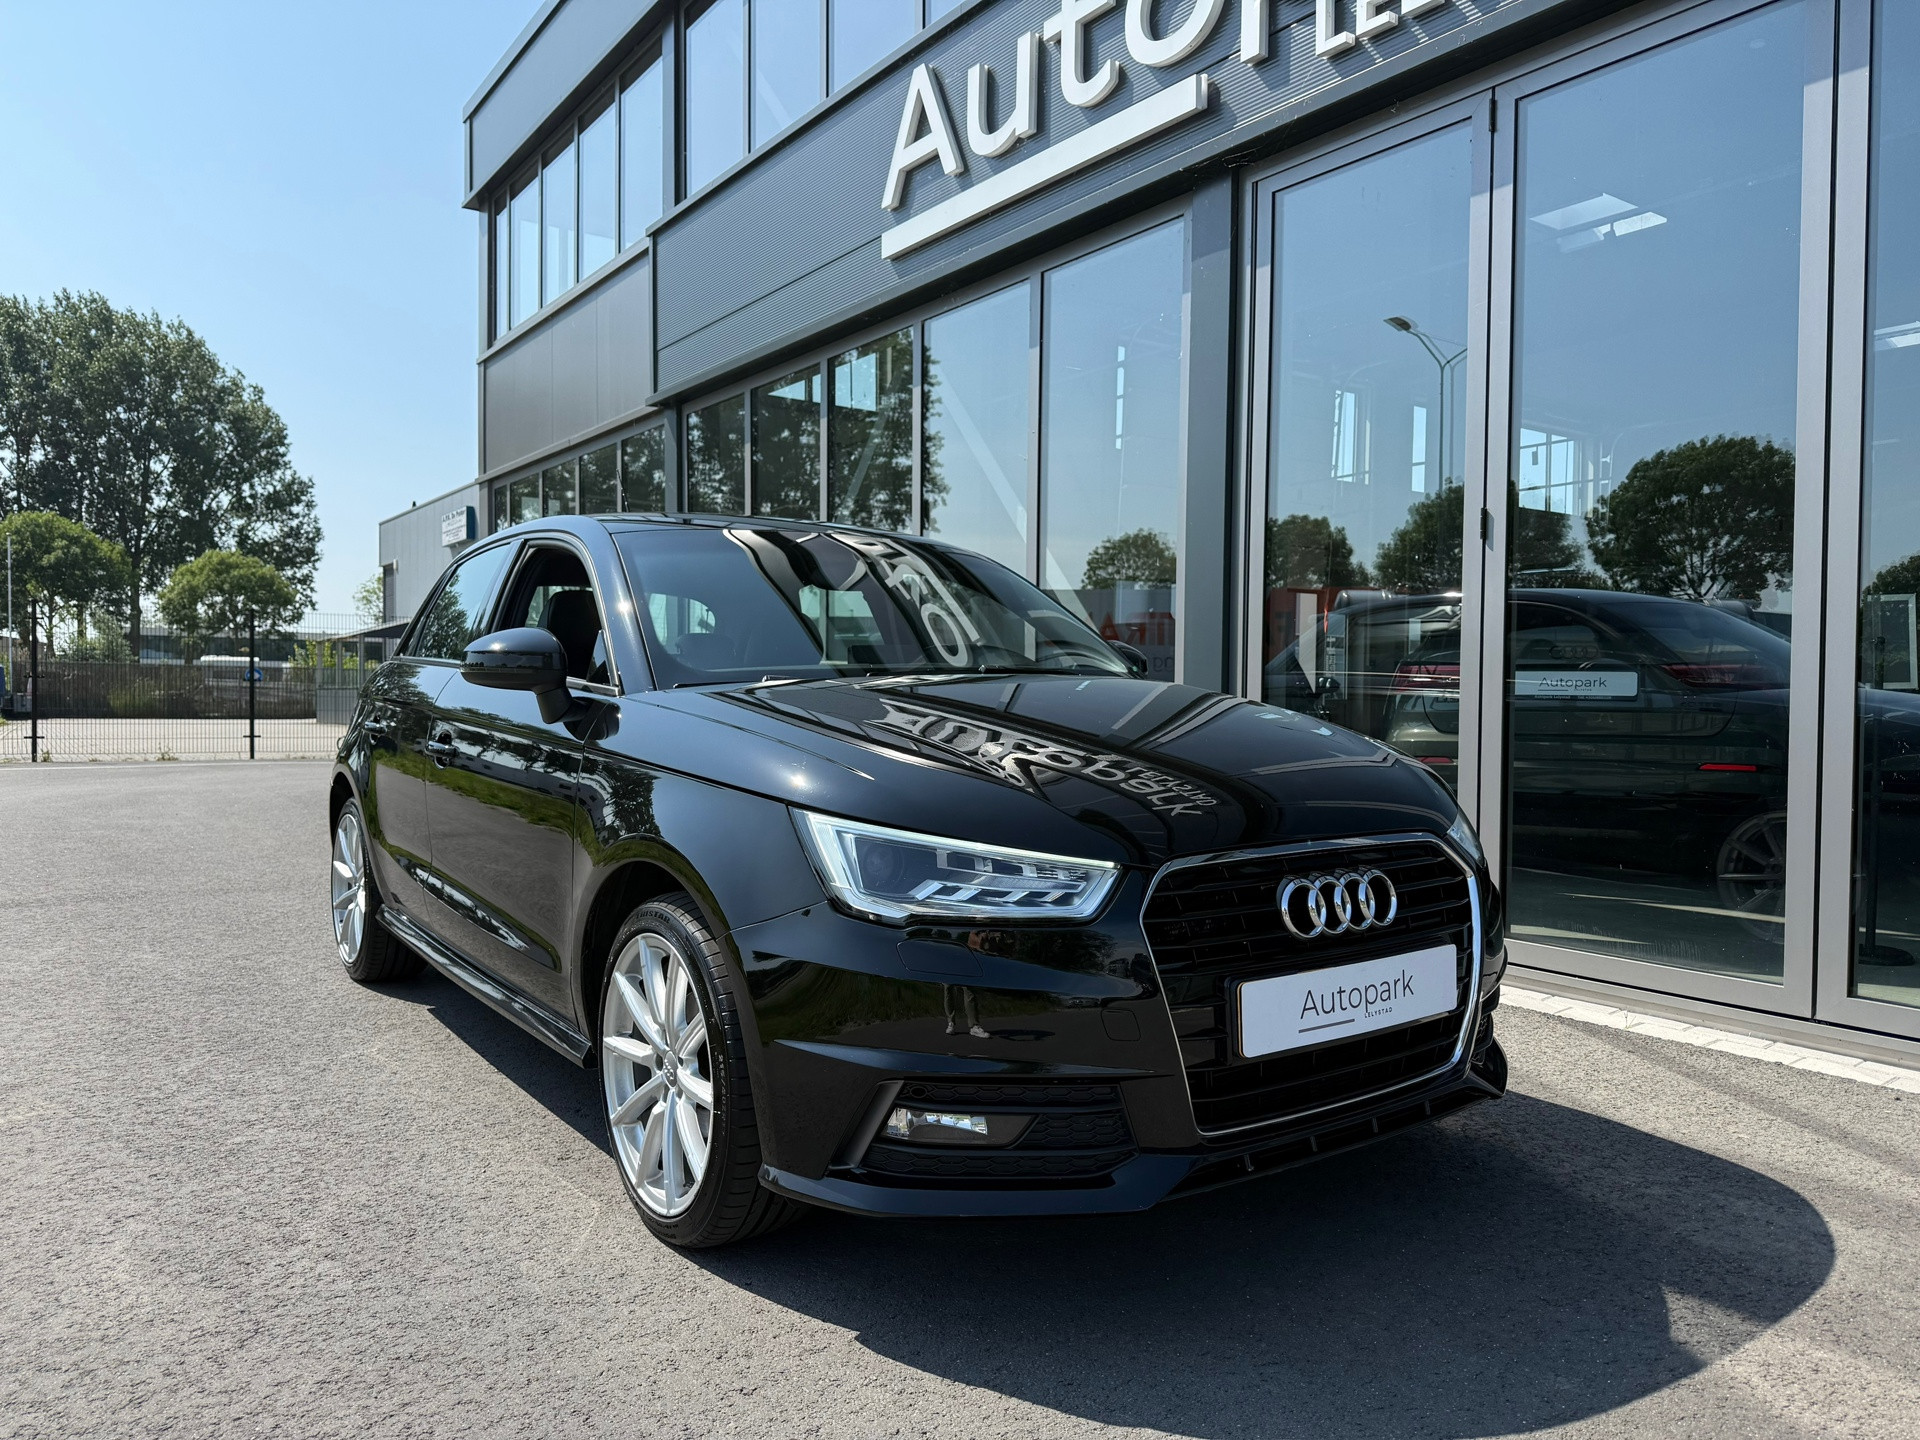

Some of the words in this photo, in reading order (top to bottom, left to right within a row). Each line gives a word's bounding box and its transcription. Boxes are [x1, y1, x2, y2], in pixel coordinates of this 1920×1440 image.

[1539, 676, 1607, 689] Autopark
[1300, 969, 1414, 1019] Autopark
[1364, 1006, 1393, 1018] LELYSTAD
